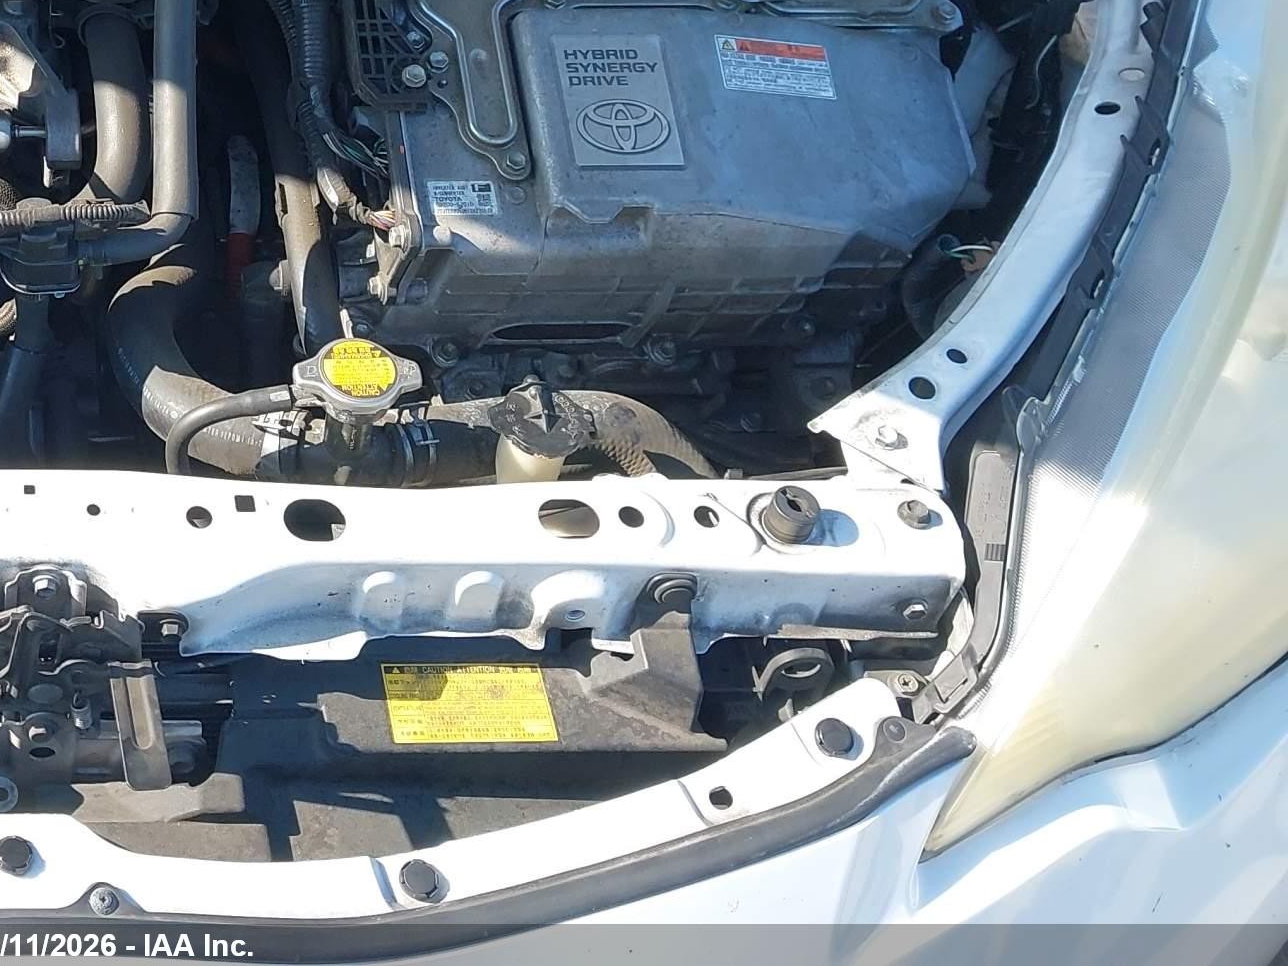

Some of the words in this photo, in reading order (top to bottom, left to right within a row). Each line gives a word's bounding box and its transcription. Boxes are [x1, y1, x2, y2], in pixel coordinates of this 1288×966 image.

[563, 49, 638, 60] HYBRID
[565, 62, 658, 73] SYNERGY
[568, 75, 629, 86] DRIVE
[351, 389, 380, 397] CAUTION
[422, 666, 453, 674] CAUTION
[456, 665, 496, 674] ATTENTION
